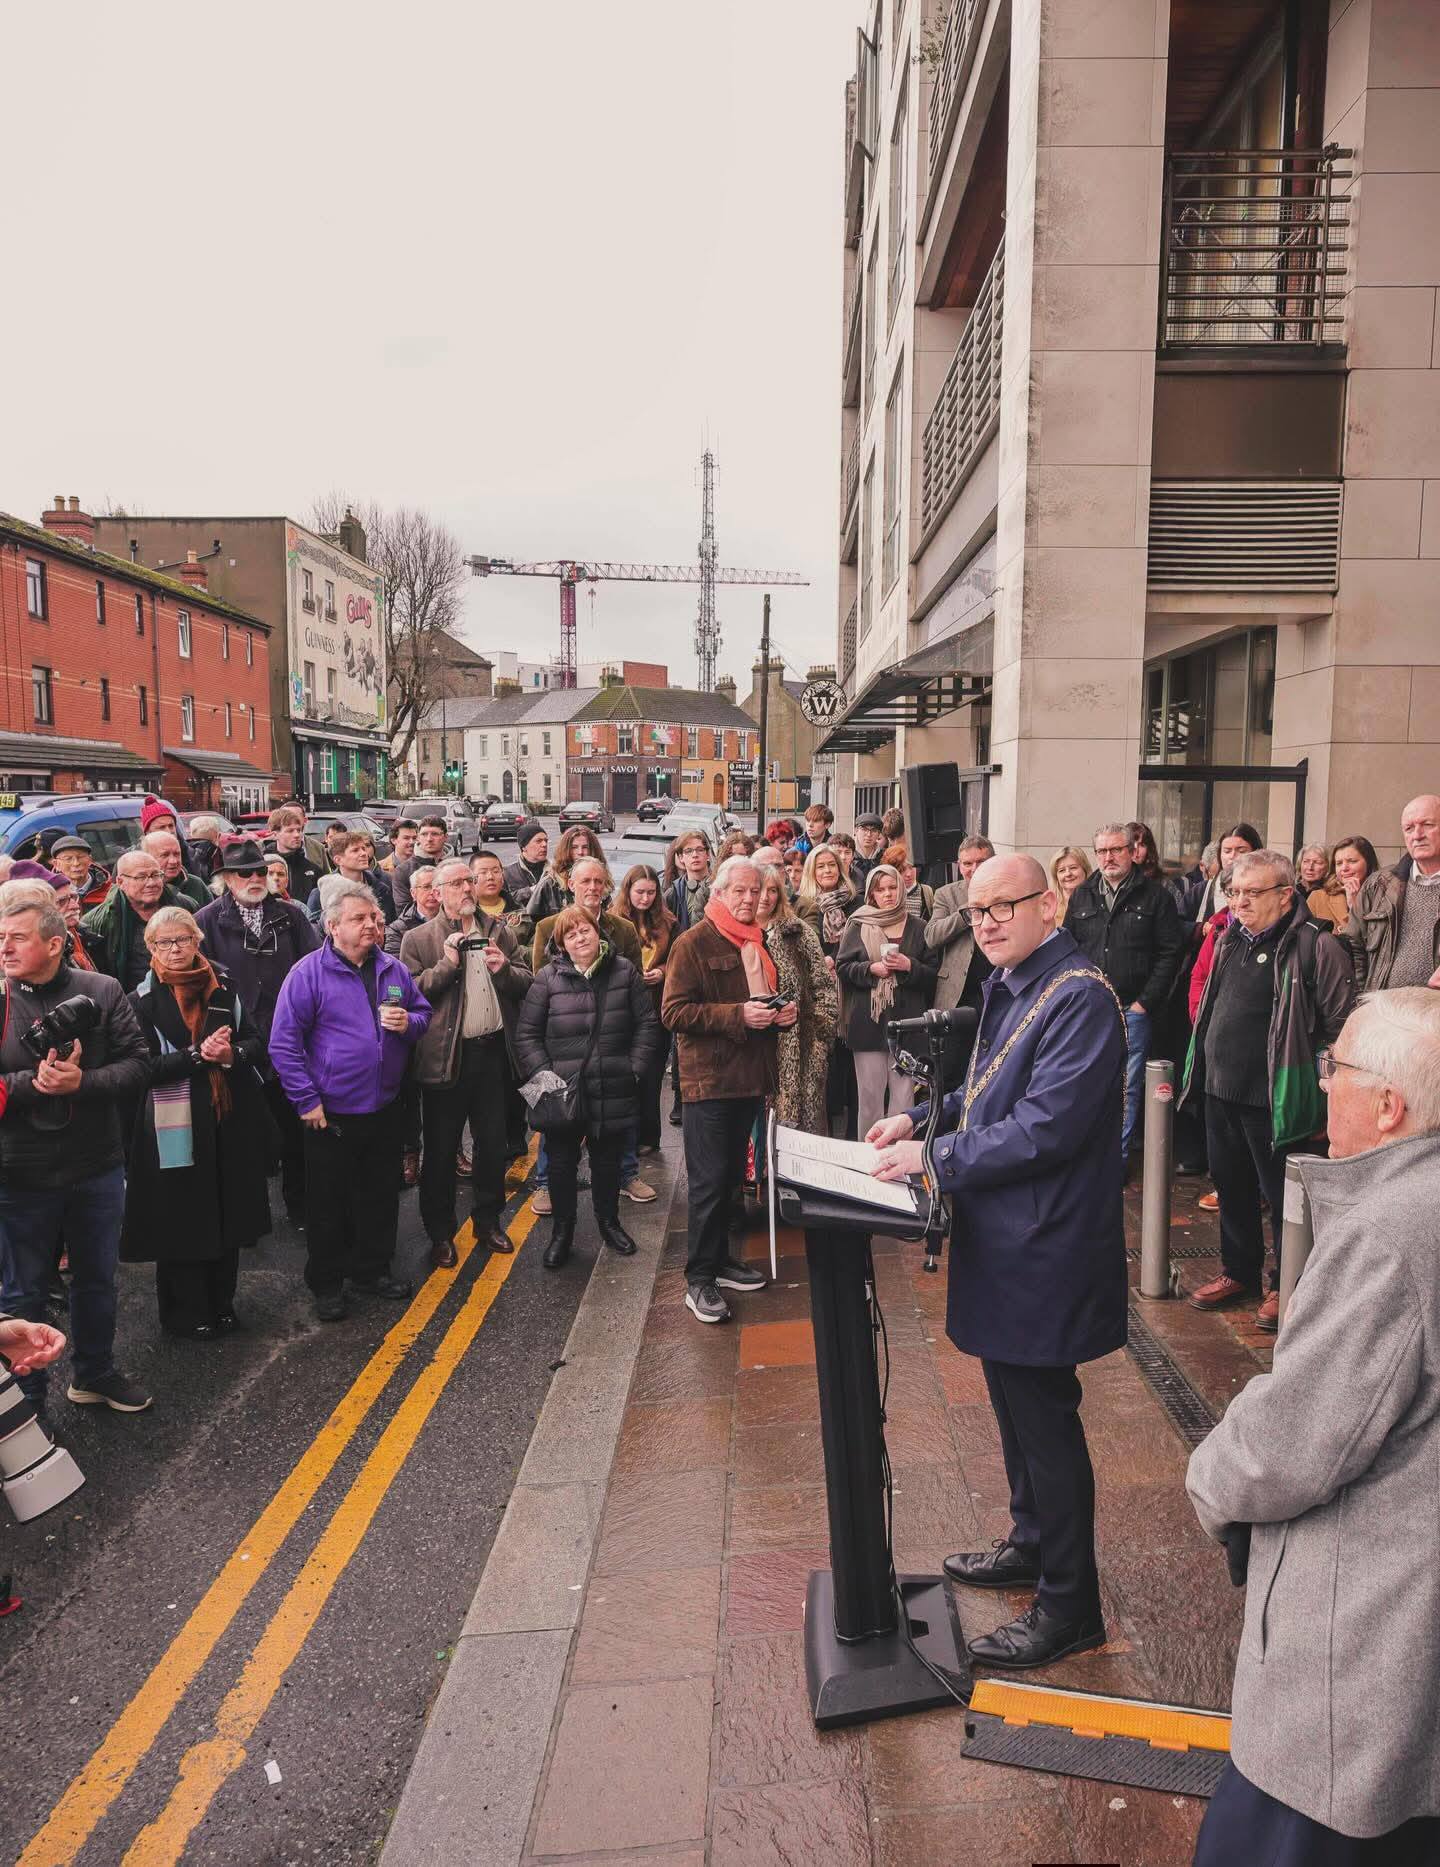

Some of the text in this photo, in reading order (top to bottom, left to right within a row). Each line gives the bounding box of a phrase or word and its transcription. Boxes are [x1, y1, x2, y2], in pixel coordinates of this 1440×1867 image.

[305, 627, 335, 655] GUINNESS
[812, 697, 836, 715] W
[610, 765, 639, 773] SAVOY
